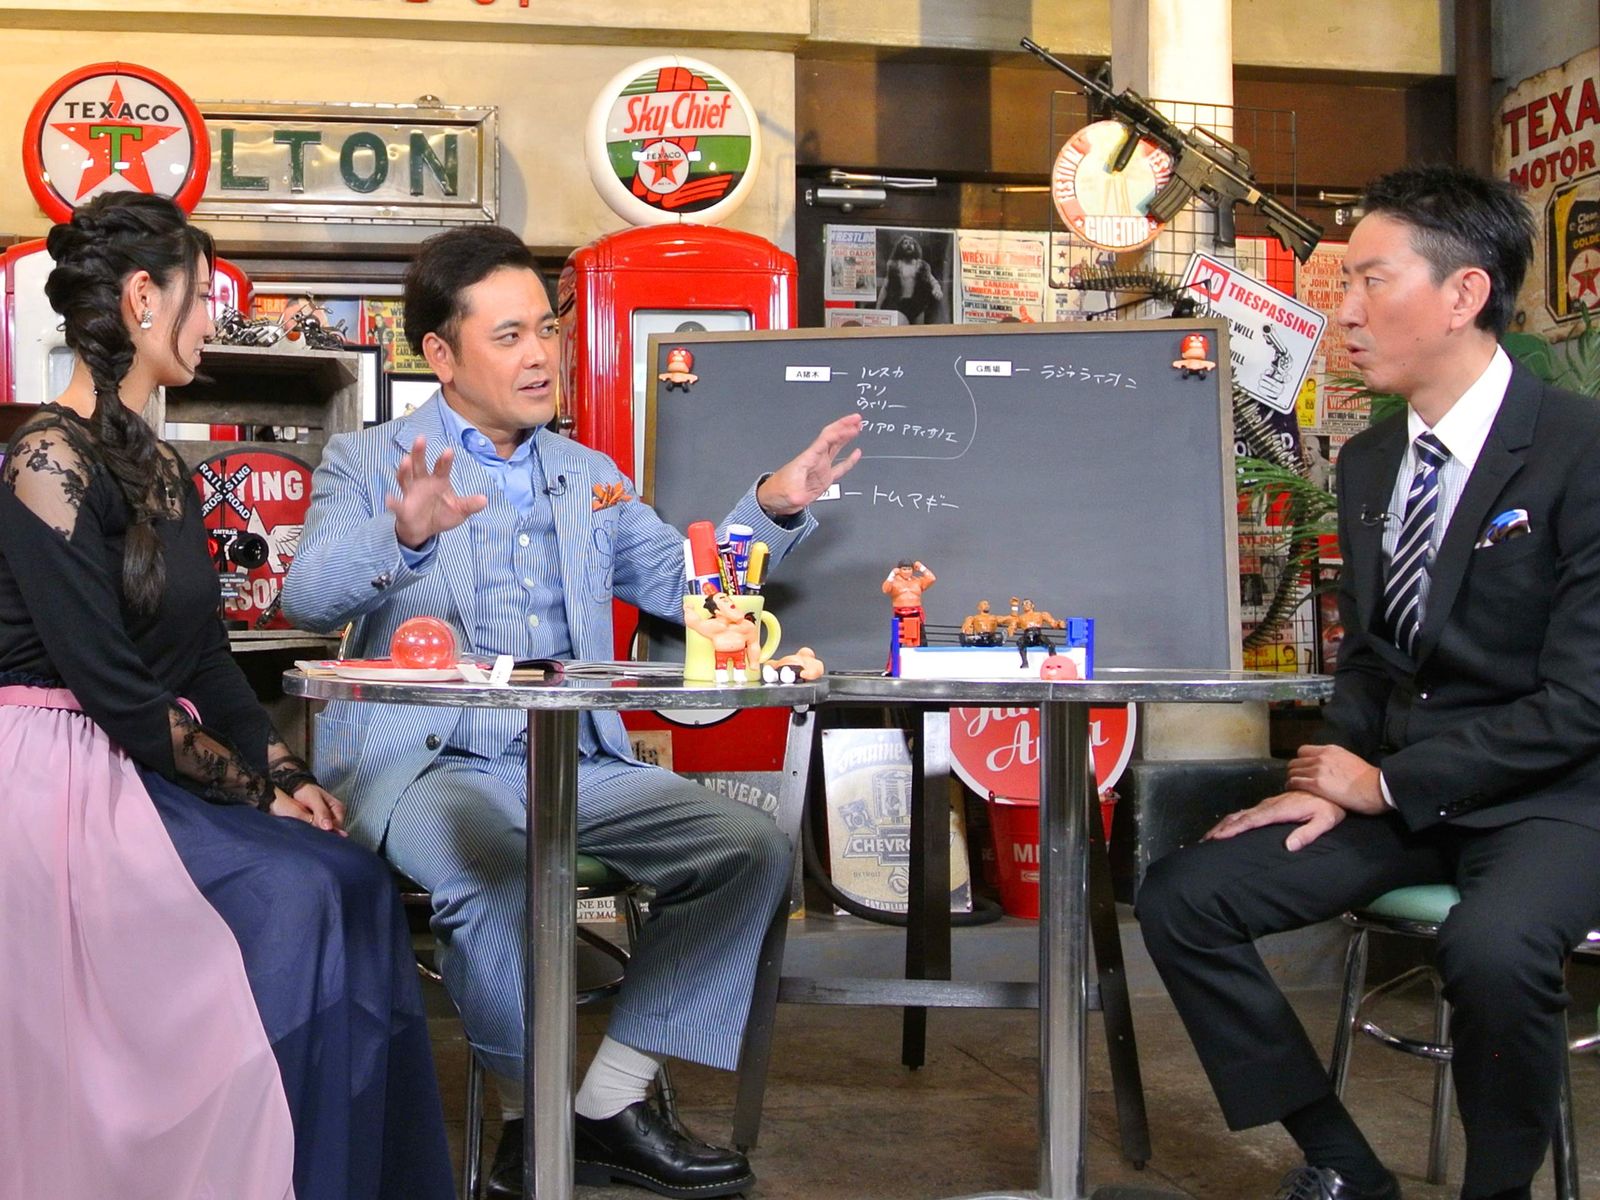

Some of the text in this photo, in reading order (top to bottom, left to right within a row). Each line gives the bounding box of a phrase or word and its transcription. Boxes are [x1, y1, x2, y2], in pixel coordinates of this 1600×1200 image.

[65, 101, 169, 122] TEXACO
[624, 92, 732, 135] Sky Chief
[221, 128, 458, 196] LTON
[1510, 140, 1596, 193] MOTOR
[1085, 216, 1149, 247] CINEMA
[1197, 264, 1225, 296] NO
[1228, 282, 1318, 340] TRESPASSING
[1234, 323, 1255, 340] WILL
[704, 778, 762, 806] NEVER
